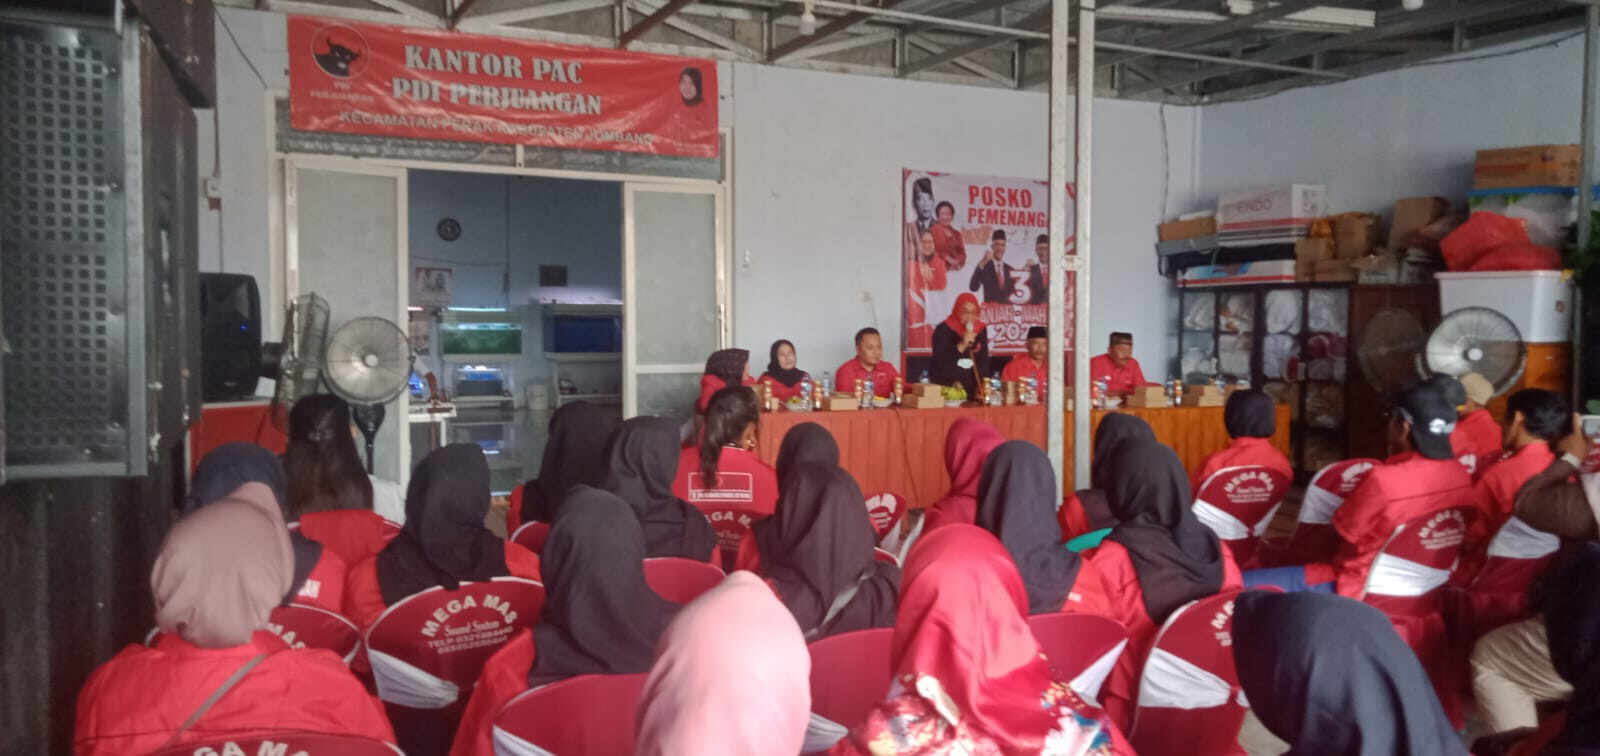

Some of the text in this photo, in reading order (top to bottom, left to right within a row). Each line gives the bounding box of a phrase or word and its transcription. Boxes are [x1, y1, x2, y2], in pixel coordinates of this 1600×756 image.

[404, 44, 583, 84] KANTOR PAC
[392, 77, 602, 116] PDI PERJUANGAN
[339, 110, 439, 129] KECAMATAN
[587, 129, 655, 146] JOMBANG
[968, 184, 1032, 209] POSKO
[967, 208, 1049, 228] PEMENANG
[1008, 270, 1032, 305] 3
[421, 595, 477, 638] MEGA
[482, 594, 517, 624] MAS
